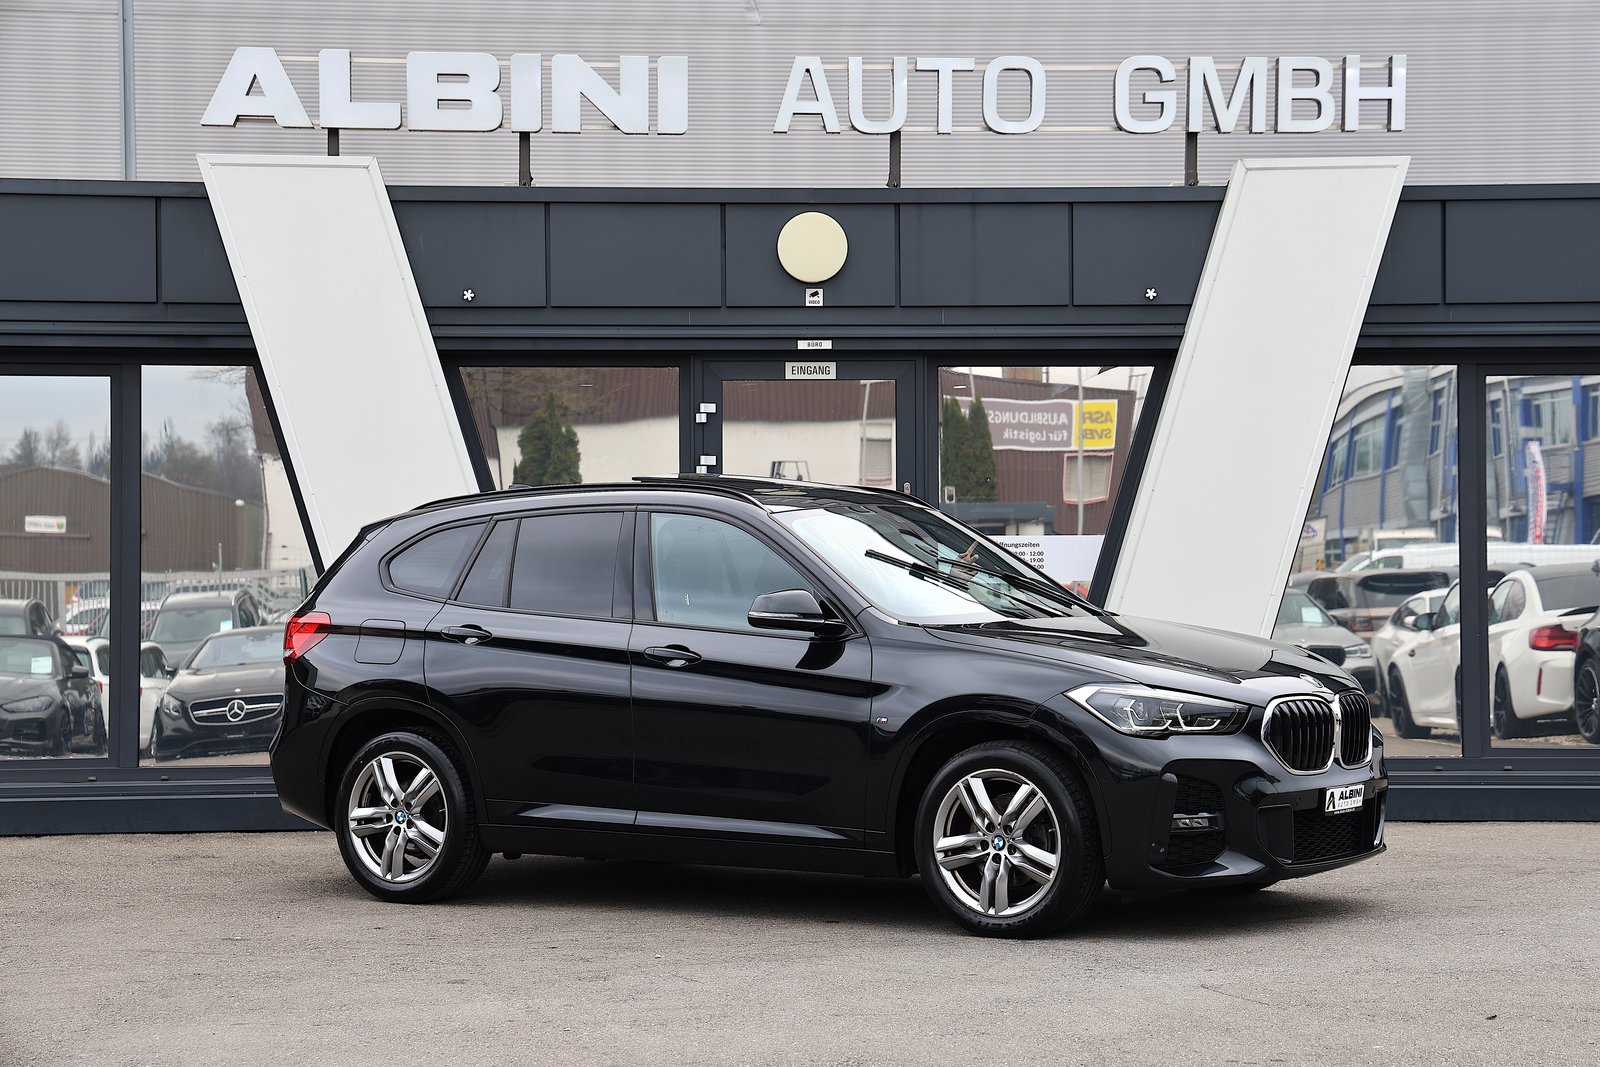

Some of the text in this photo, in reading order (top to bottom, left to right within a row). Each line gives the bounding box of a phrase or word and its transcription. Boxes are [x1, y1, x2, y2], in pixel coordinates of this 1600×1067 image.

[200, 46, 1407, 135] ALBINI AUTO GMBH
[791, 365, 831, 375] EINGANG
[997, 541, 1040, 549] ffnungszeiten
[1339, 788, 1363, 800] ALBINI
